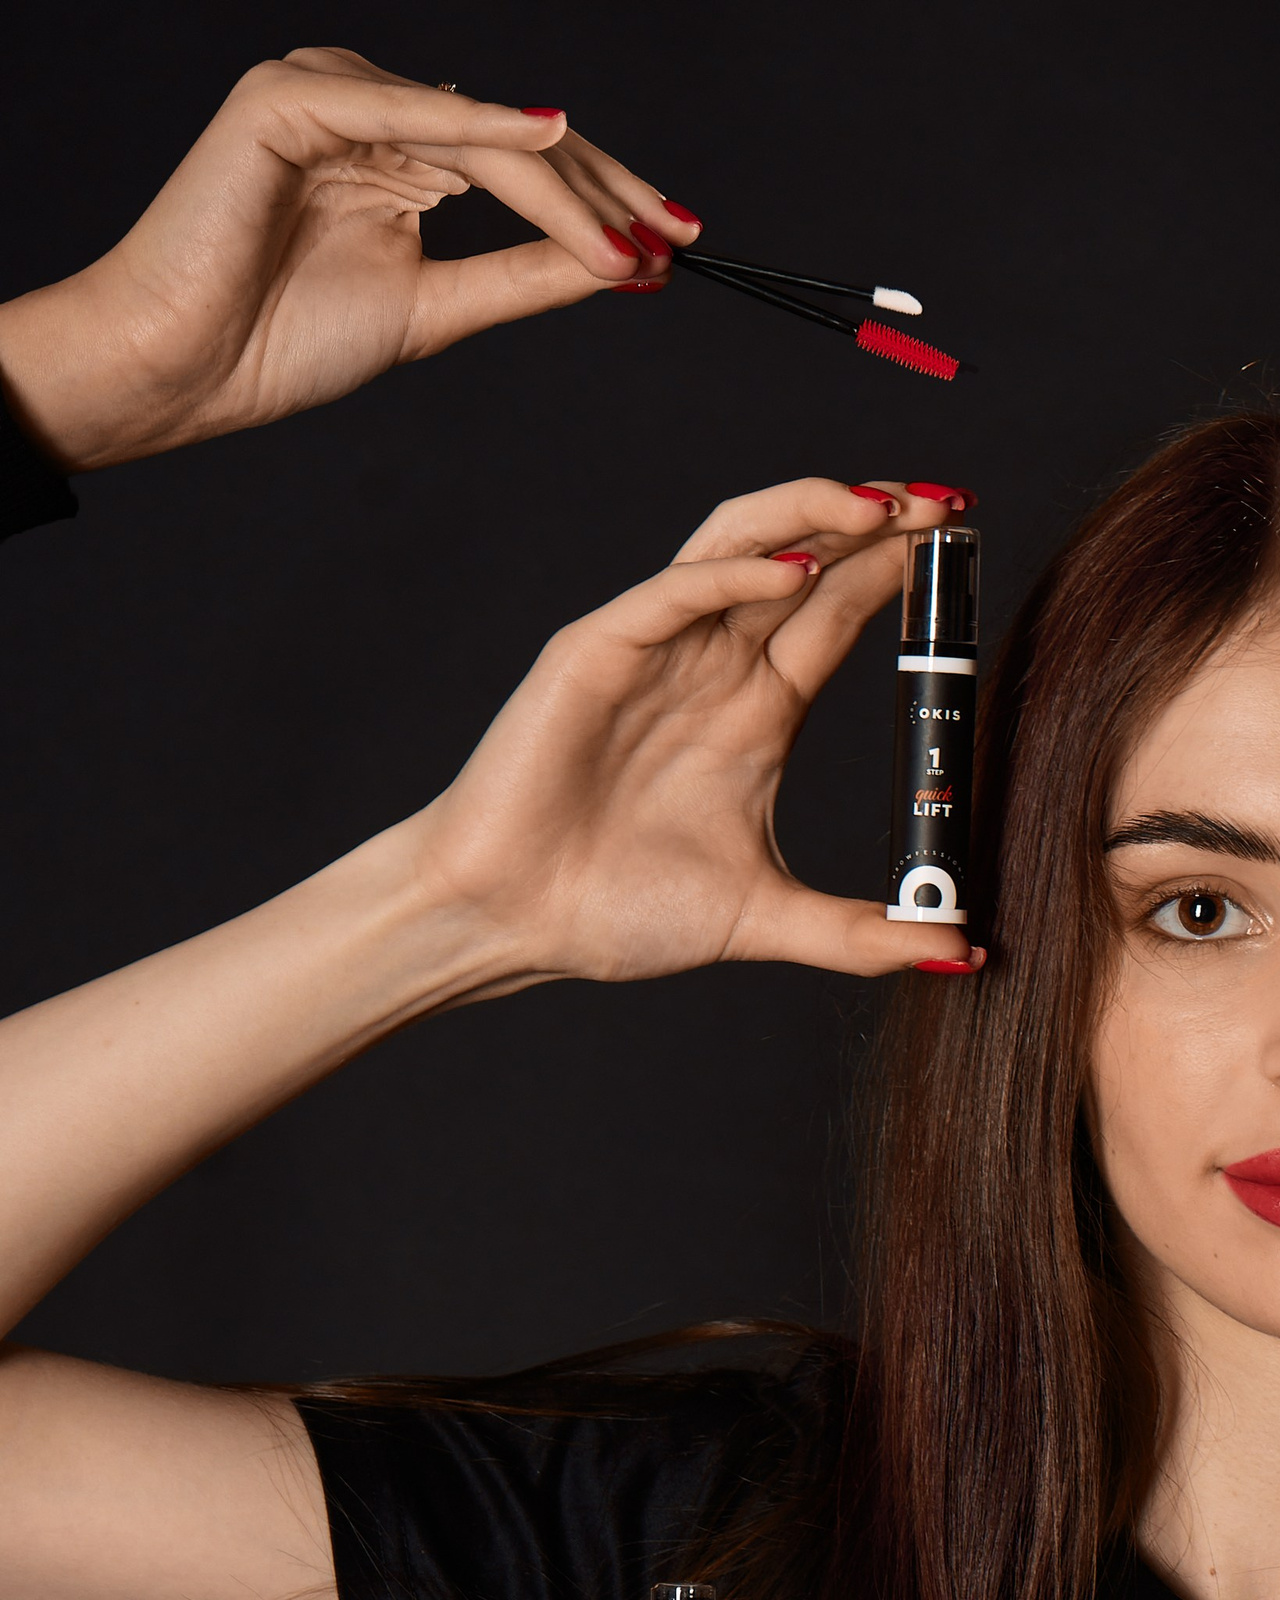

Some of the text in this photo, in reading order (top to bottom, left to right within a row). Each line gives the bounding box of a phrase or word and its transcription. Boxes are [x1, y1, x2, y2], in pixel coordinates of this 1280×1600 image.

[919, 707, 961, 721] OKIS
[928, 747, 940, 769] 1
[926, 768, 945, 776] STEP
[914, 785, 953, 805] quick
[913, 802, 953, 818] LIFT
